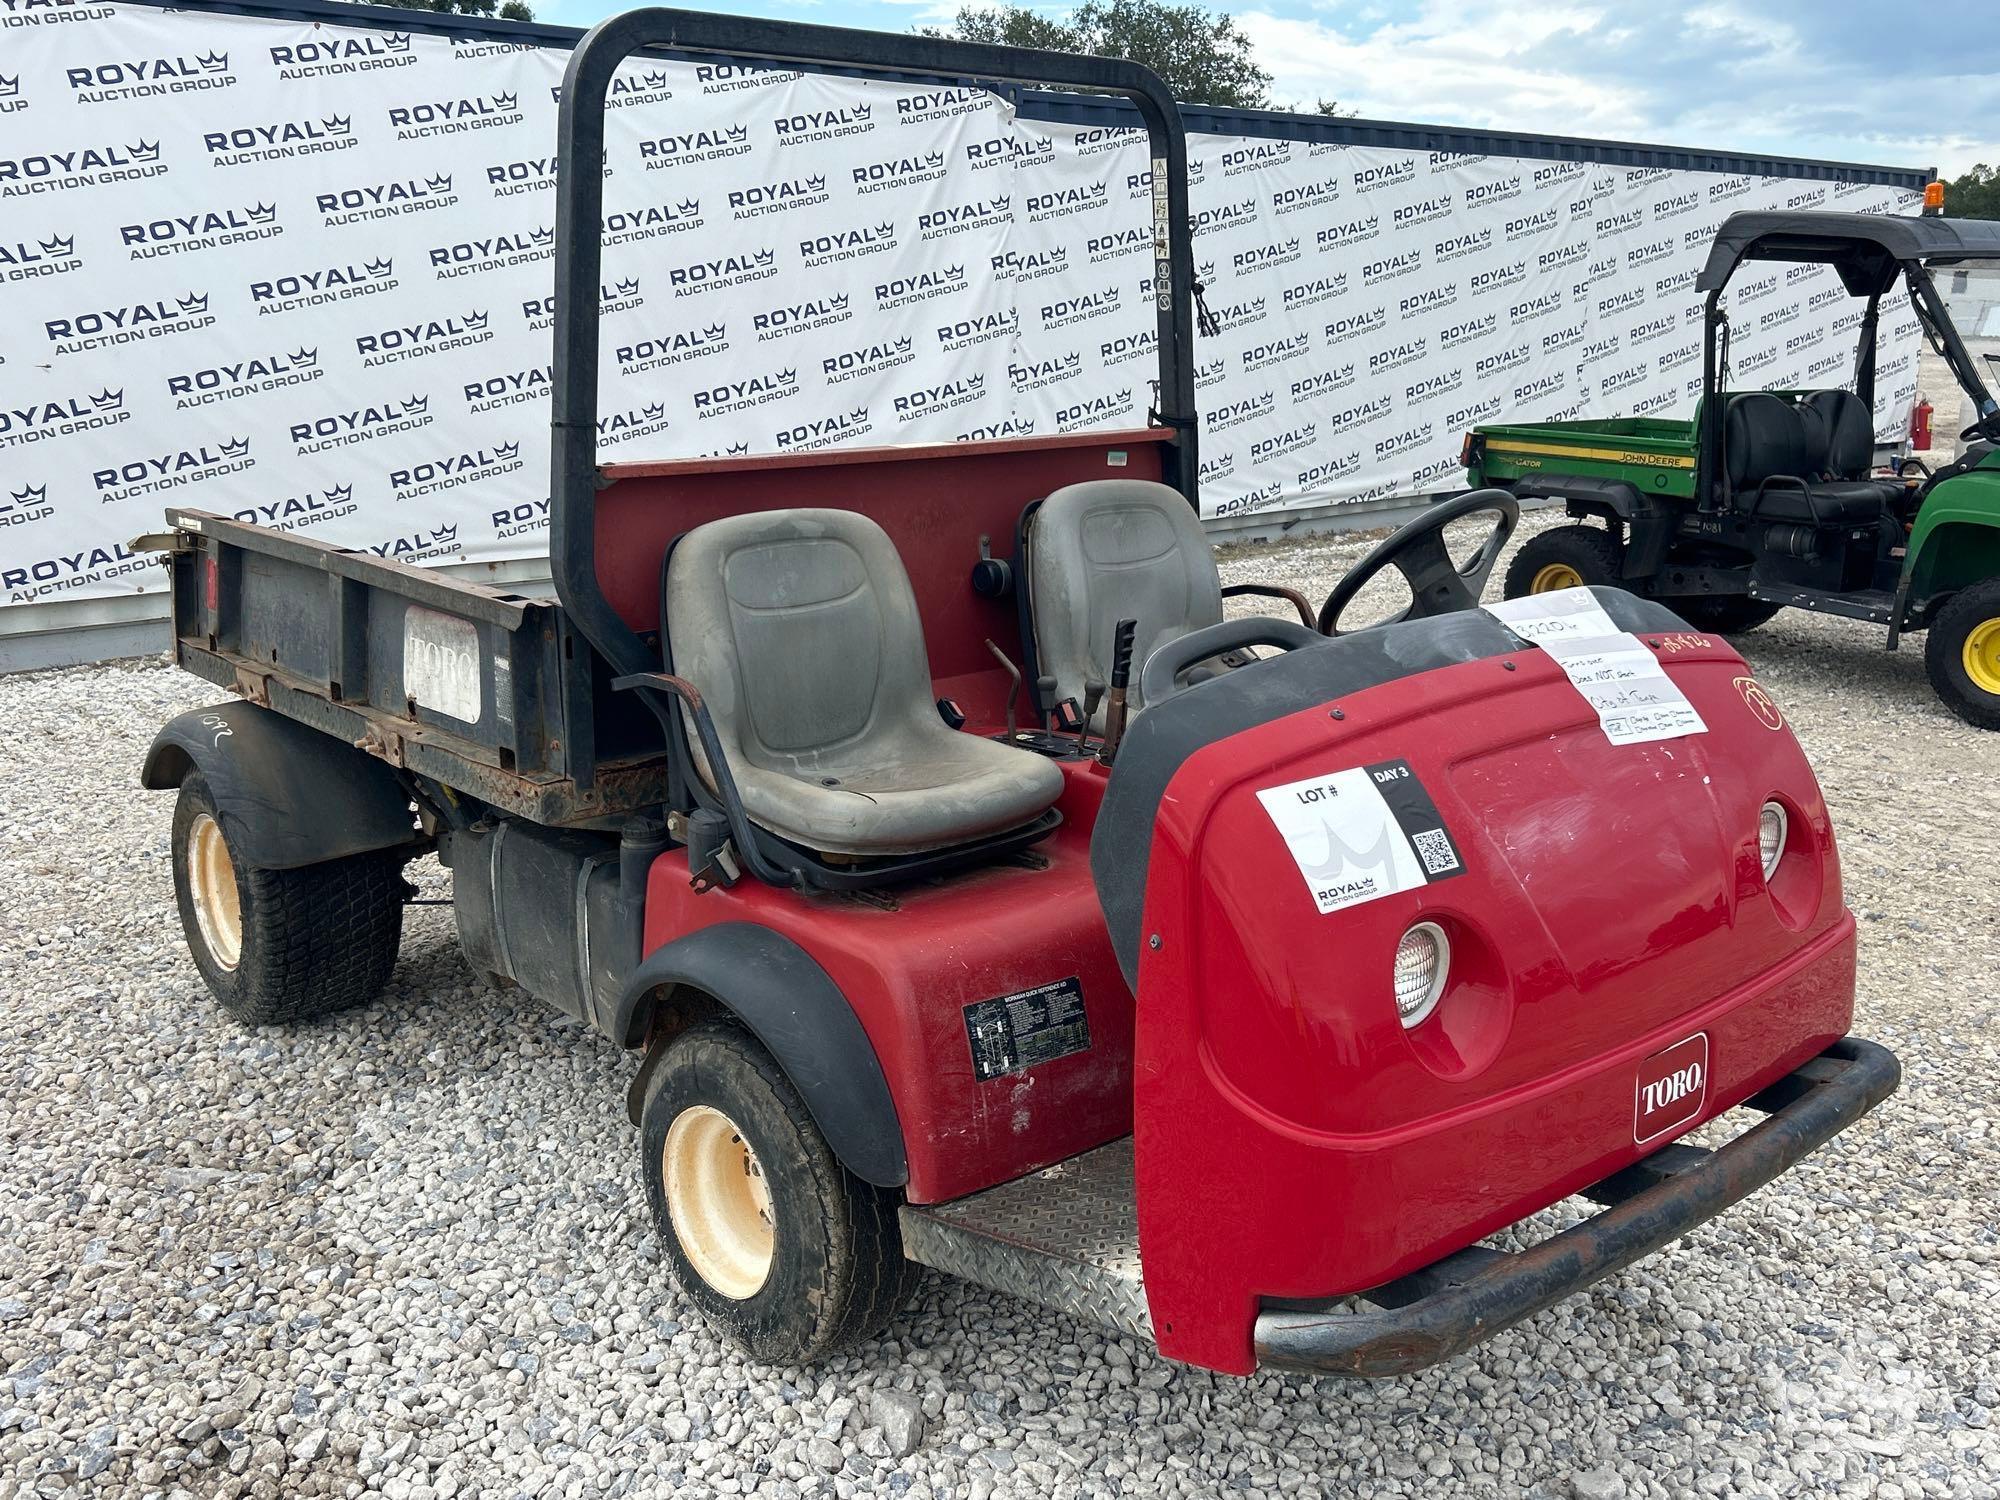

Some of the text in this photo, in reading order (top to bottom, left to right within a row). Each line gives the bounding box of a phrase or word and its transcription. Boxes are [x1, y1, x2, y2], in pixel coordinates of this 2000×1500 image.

[270, 38, 385, 65] ROYAL
[66, 58, 199, 88] ROYAL
[280, 56, 417, 80] AUCTION GROUP
[78, 76, 236, 104] AUCTION GROUP
[389, 98, 494, 127] ROYAL
[774, 109, 853, 135] ROYAL
[203, 121, 325, 152] ROYAL
[398, 114, 523, 140] AUCTION GROUP
[780, 123, 874, 147] AUCTION GROUP
[214, 138, 358, 167] AUCTION GROUP
[639, 130, 727, 158] ROYAL
[646, 145, 751, 171] AUCTION GROUP
[853, 157, 926, 183] ROYAL
[728, 180, 807, 208] ROYAL
[858, 169, 947, 195] AUCTION GROUP
[1274, 183, 1325, 206] ROYAL
[1466, 180, 1509, 201] ROYAL
[316, 181, 427, 213] ROYAL
[734, 194, 829, 220] AUCTION GROUP
[1275, 193, 1339, 215] AUCTION GROUP
[1467, 189, 1521, 209] AUCTION GROUP
[1654, 195, 1689, 214] ROYAL
[325, 196, 458, 227] AUCTION GROUP
[1394, 200, 1439, 222] ROYAL
[1395, 209, 1452, 230] AUCTION GROUP
[1506, 213, 1547, 234] ROYAL
[1597, 213, 1632, 232] ROYAL
[120, 210, 248, 245] ROYAL
[1507, 222, 1558, 242] AUCTION GROUP
[131, 226, 283, 260] AUCTION GROUP
[800, 229, 876, 257] ROYAL
[805, 241, 897, 268] AUCTION GROUP
[250, 266, 366, 301] ROYAL
[670, 255, 754, 286] ROYAL
[675, 268, 777, 298] AUCTION GROUP
[259, 281, 398, 316] AUCTION GROUP
[875, 272, 945, 300] ROYAL
[879, 282, 968, 311] AUCTION GROUP
[1739, 280, 1768, 298] ROYAL
[753, 300, 830, 330] ROYAL
[1041, 293, 1103, 320] ROYAL
[1044, 303, 1121, 331] AUCTION GROUP
[1761, 307, 1791, 325] ROYAL
[45, 302, 179, 340] ROYAL
[758, 312, 852, 342] AUCTION GROUP
[1441, 319, 1484, 342] ROYAL
[56, 318, 215, 355] AUCTION GROUP
[356, 319, 464, 355] ROYAL
[616, 331, 704, 364] ROYAL
[1442, 327, 1496, 350] AUCTION GROUP
[364, 334, 493, 368] AUCTION GROUP
[622, 343, 729, 376] AUCTION GROUP
[1243, 338, 1295, 364] ROYAL
[1245, 347, 1309, 373] AUCTION GROUP
[1370, 344, 1414, 368] ROYAL
[1371, 352, 1427, 376] AUCTION GROUP
[168, 357, 290, 396] ROYAL
[177, 368, 324, 410] AUCTION GROUP
[694, 376, 777, 408] ROYAL
[699, 386, 799, 420] AUCTION GROUP
[894, 381, 967, 412] ROYAL
[899, 390, 986, 422] AUCTION GROUP
[1207, 398, 1260, 425] ROYAL
[1332, 401, 1379, 427] ROYAL
[290, 404, 402, 443] ROYAL
[1209, 407, 1274, 434] AUCTION GROUP
[1334, 409, 1392, 435] AUCTION GROUP
[298, 418, 433, 456] AUCTION GROUP
[1251, 430, 1302, 457] ROYAL
[1375, 429, 1420, 454] ROYAL
[1377, 436, 1432, 463] AUCTION GROUP
[1253, 438, 1316, 466] AUCTION GROUP
[1516, 458, 1542, 468] GATOR
[1620, 453, 1681, 466] JOHN DEERE
[93, 448, 220, 490] ROYAL
[102, 460, 255, 504] AUCTION GROUP
[390, 451, 494, 488] ROYAL
[396, 463, 523, 501] AUCTION GROUP
[1596, 669, 1616, 680] NOT
[1374, 766, 1410, 783] DAY 3
[1297, 784, 1338, 804] LOT #
[1318, 881, 1364, 901] ROYAL
[1322, 886, 1378, 908] AUCTION GROUP
[1642, 1062, 1702, 1116] TORO
